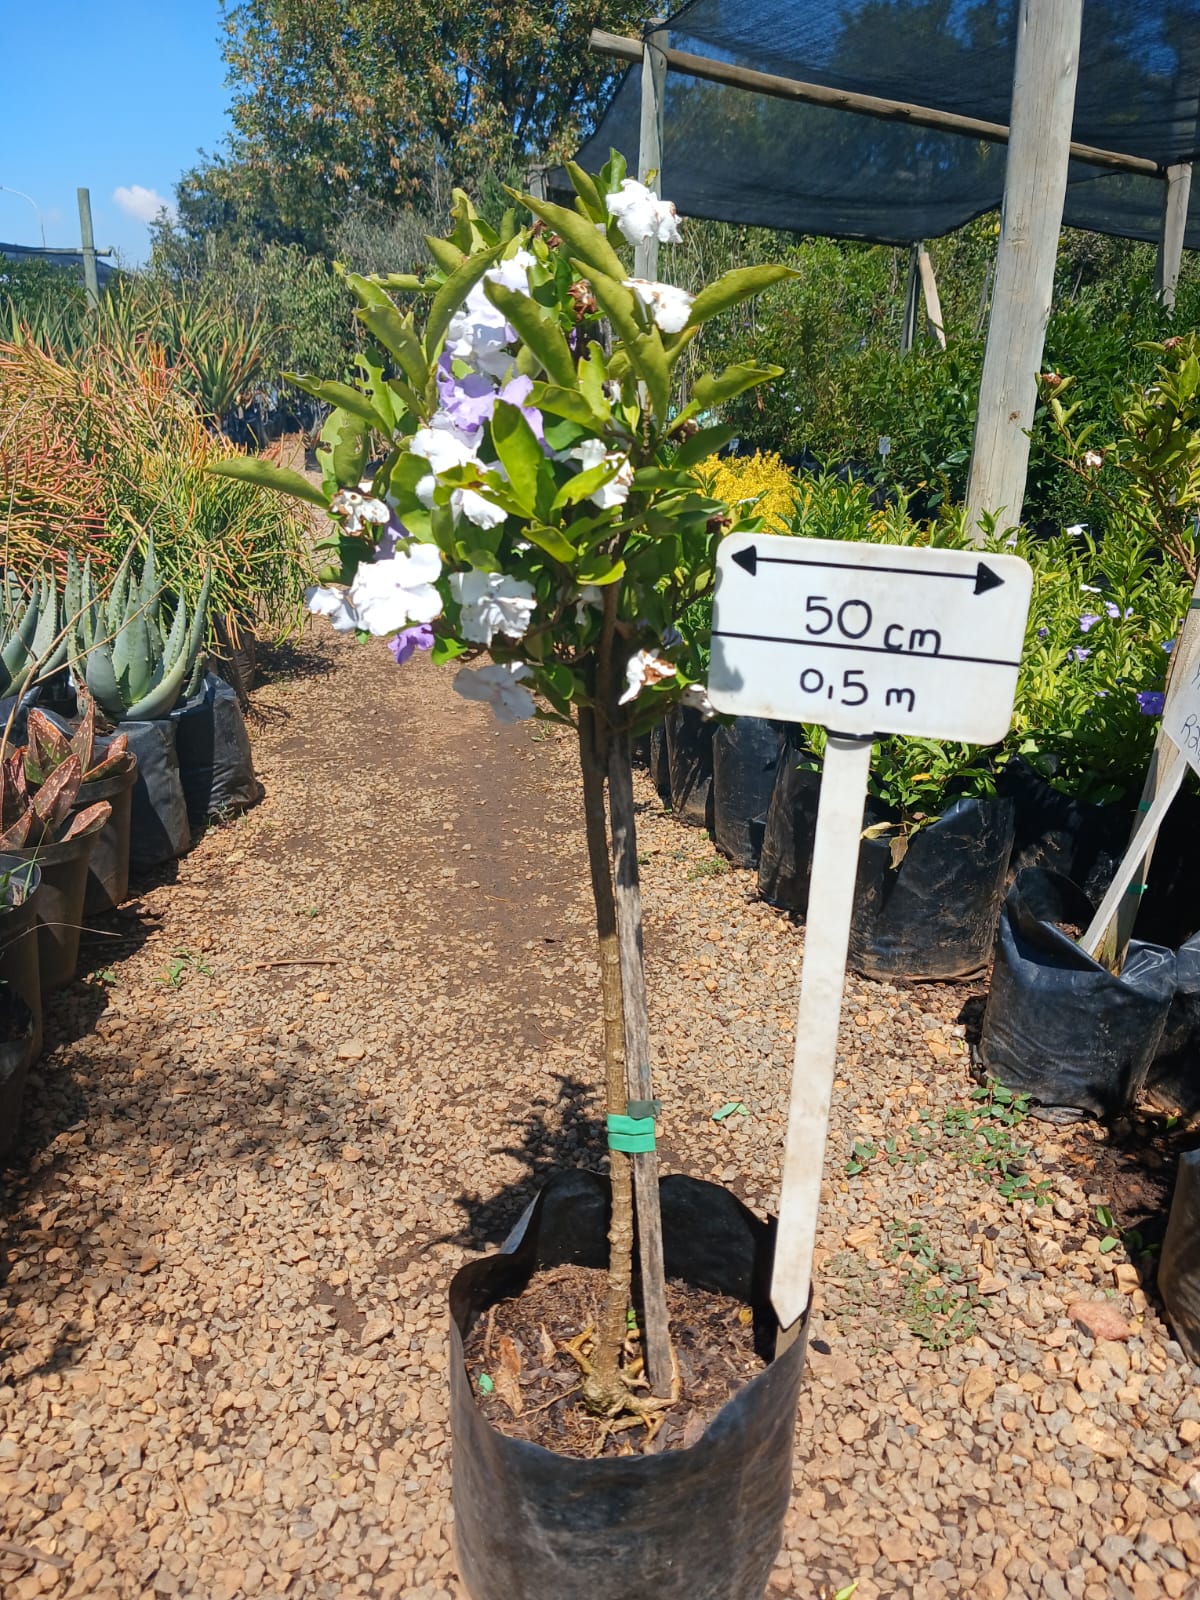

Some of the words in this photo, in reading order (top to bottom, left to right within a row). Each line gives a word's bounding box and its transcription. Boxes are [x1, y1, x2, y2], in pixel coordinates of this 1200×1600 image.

[805, 596, 873, 640] 50
[883, 623, 942, 656] cm
[799, 668, 869, 706] 0,5
[885, 687, 916, 713] m
